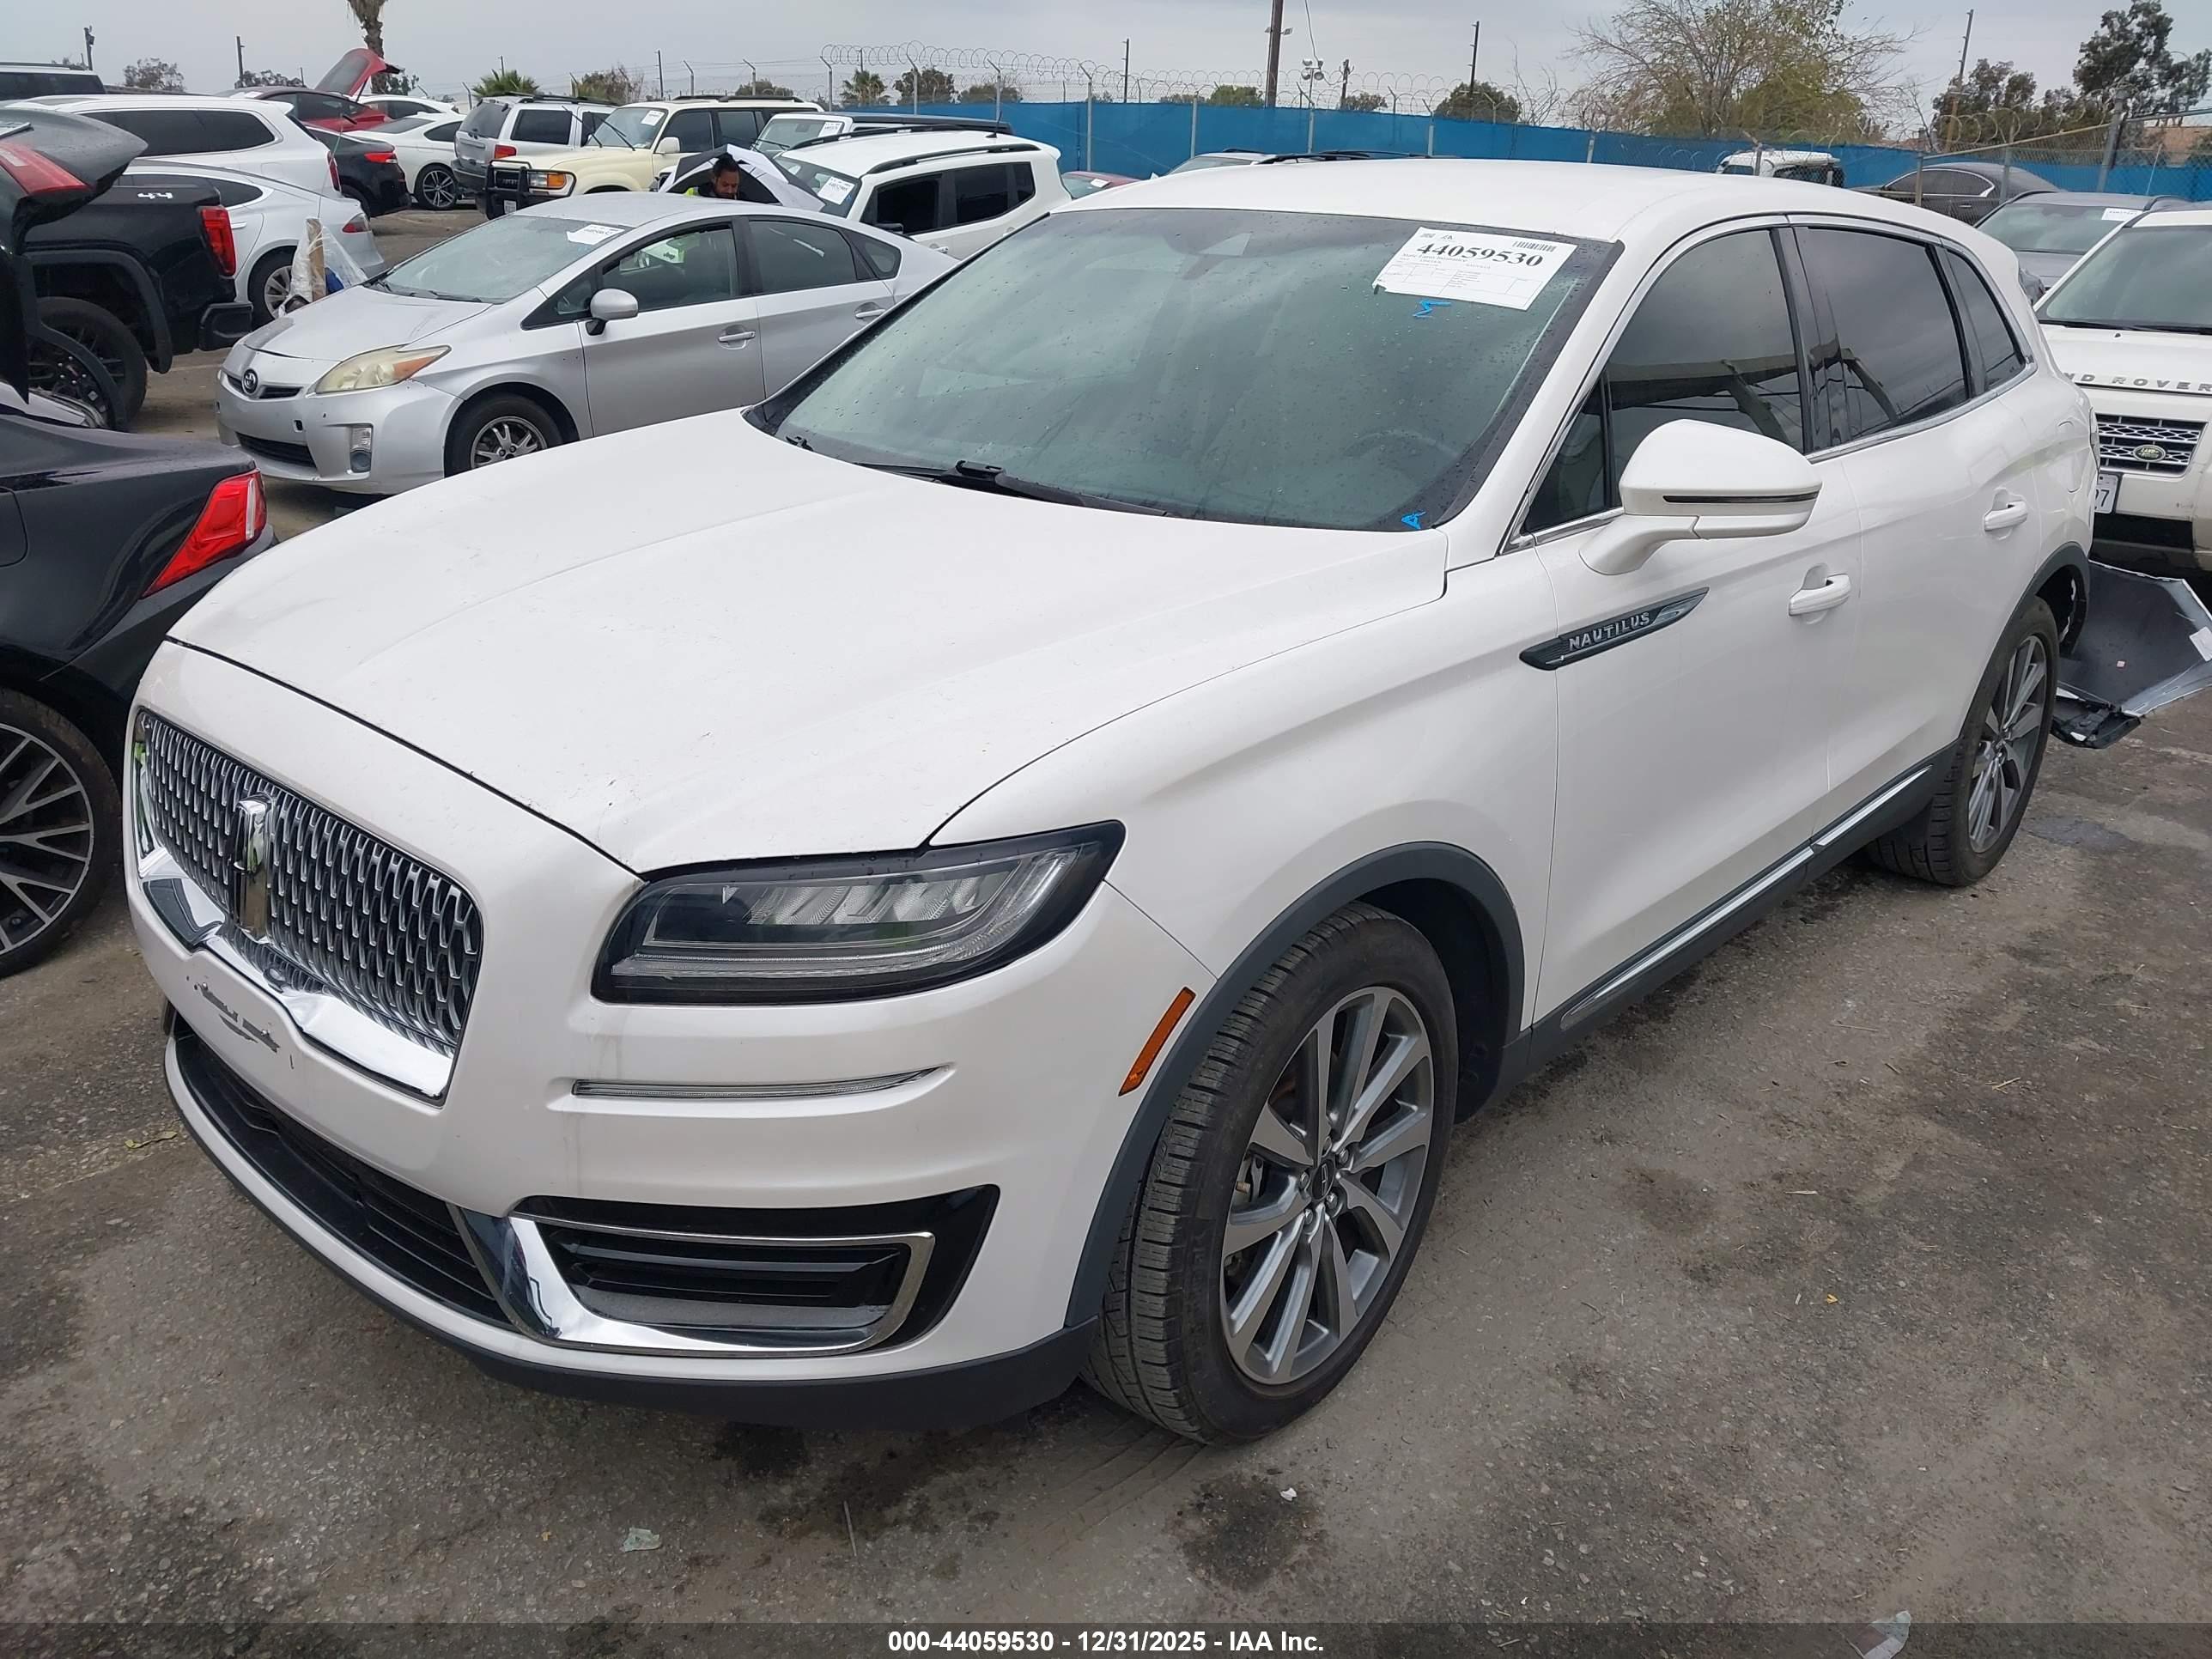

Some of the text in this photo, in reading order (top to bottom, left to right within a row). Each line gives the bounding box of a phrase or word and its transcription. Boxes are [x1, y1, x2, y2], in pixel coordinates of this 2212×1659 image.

[1417, 243, 1544, 266] 44059530
[2112, 376, 2212, 392] ROVER
[1568, 611, 1650, 651] NAUTILUS
